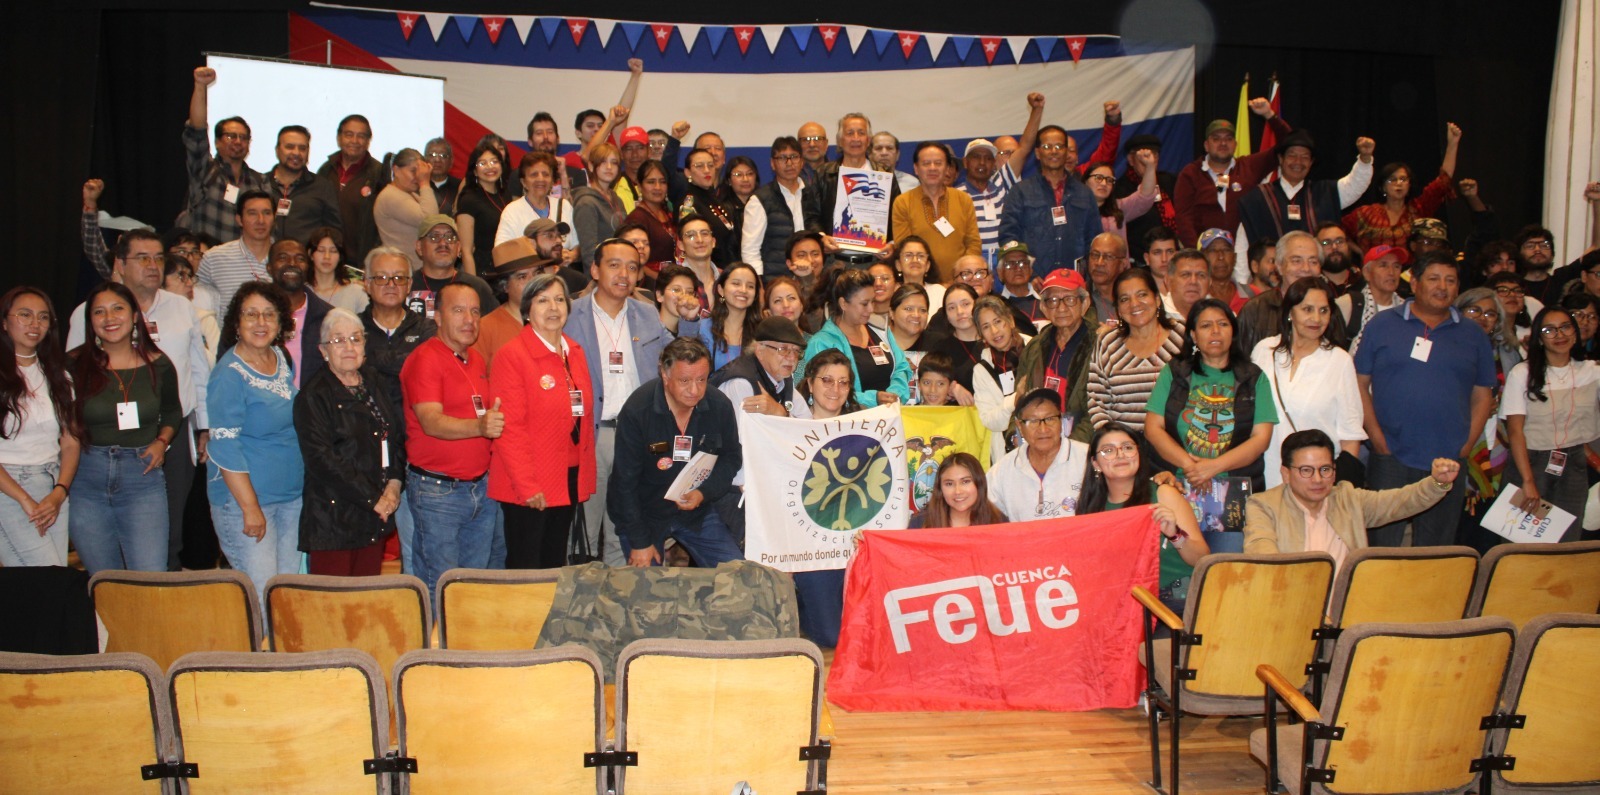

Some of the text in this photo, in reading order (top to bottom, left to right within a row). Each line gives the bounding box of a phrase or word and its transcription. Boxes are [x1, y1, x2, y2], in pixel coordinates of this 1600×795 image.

[793, 419, 905, 461] UNITIERRA
[787, 478, 905, 544] Organizaci Social
[1518, 512, 1533, 531] OLA
[1533, 517, 1552, 538] CUBA
[761, 553, 777, 564] Por
[788, 551, 813, 563] mundo
[815, 548, 841, 562] donde
[992, 564, 1072, 587] CUENCA
